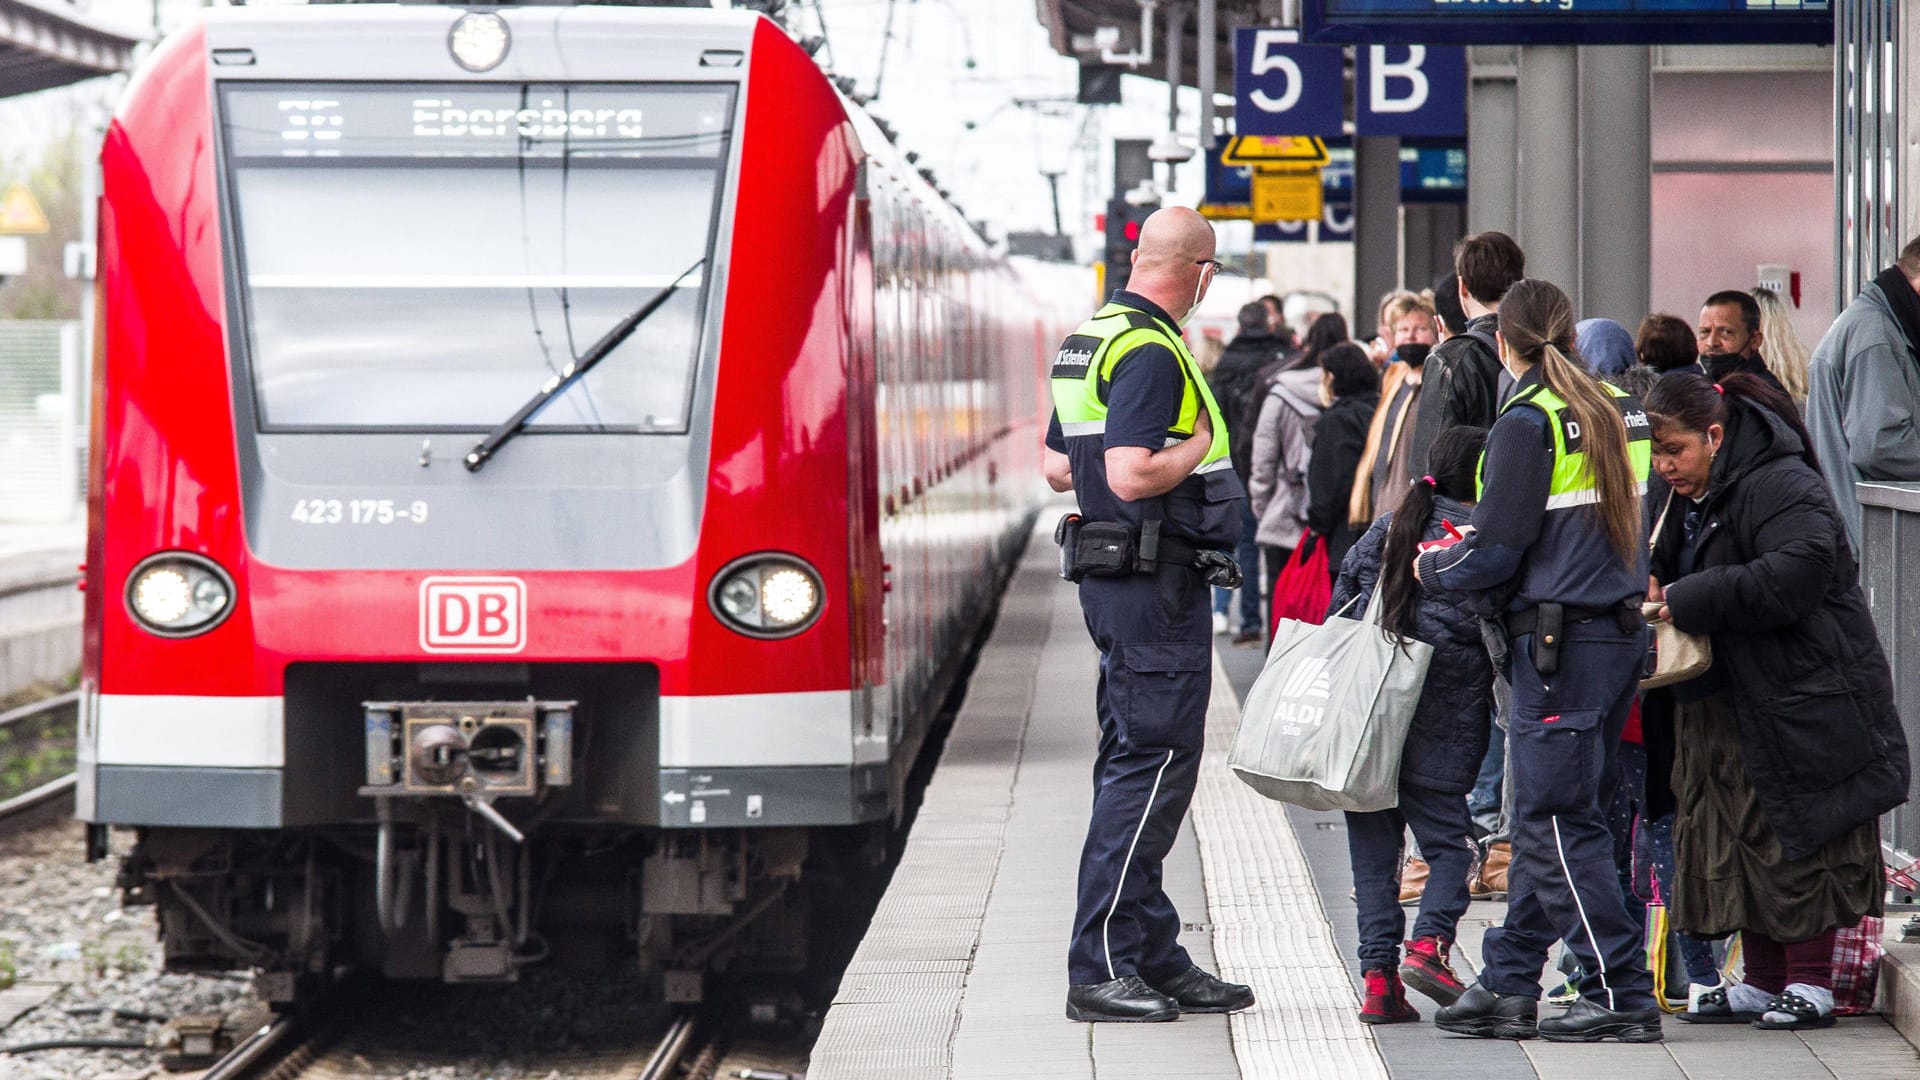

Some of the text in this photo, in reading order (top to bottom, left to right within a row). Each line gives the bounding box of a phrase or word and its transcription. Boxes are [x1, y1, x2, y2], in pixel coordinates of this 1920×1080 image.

[1250, 30, 1303, 113] 5
[1370, 44, 1429, 113] B
[412, 99, 642, 138] Ebersberg
[1567, 421, 1581, 439] D
[291, 499, 428, 524] 423 175-9
[438, 593, 509, 636] DB
[1274, 701, 1324, 726] ALDI
